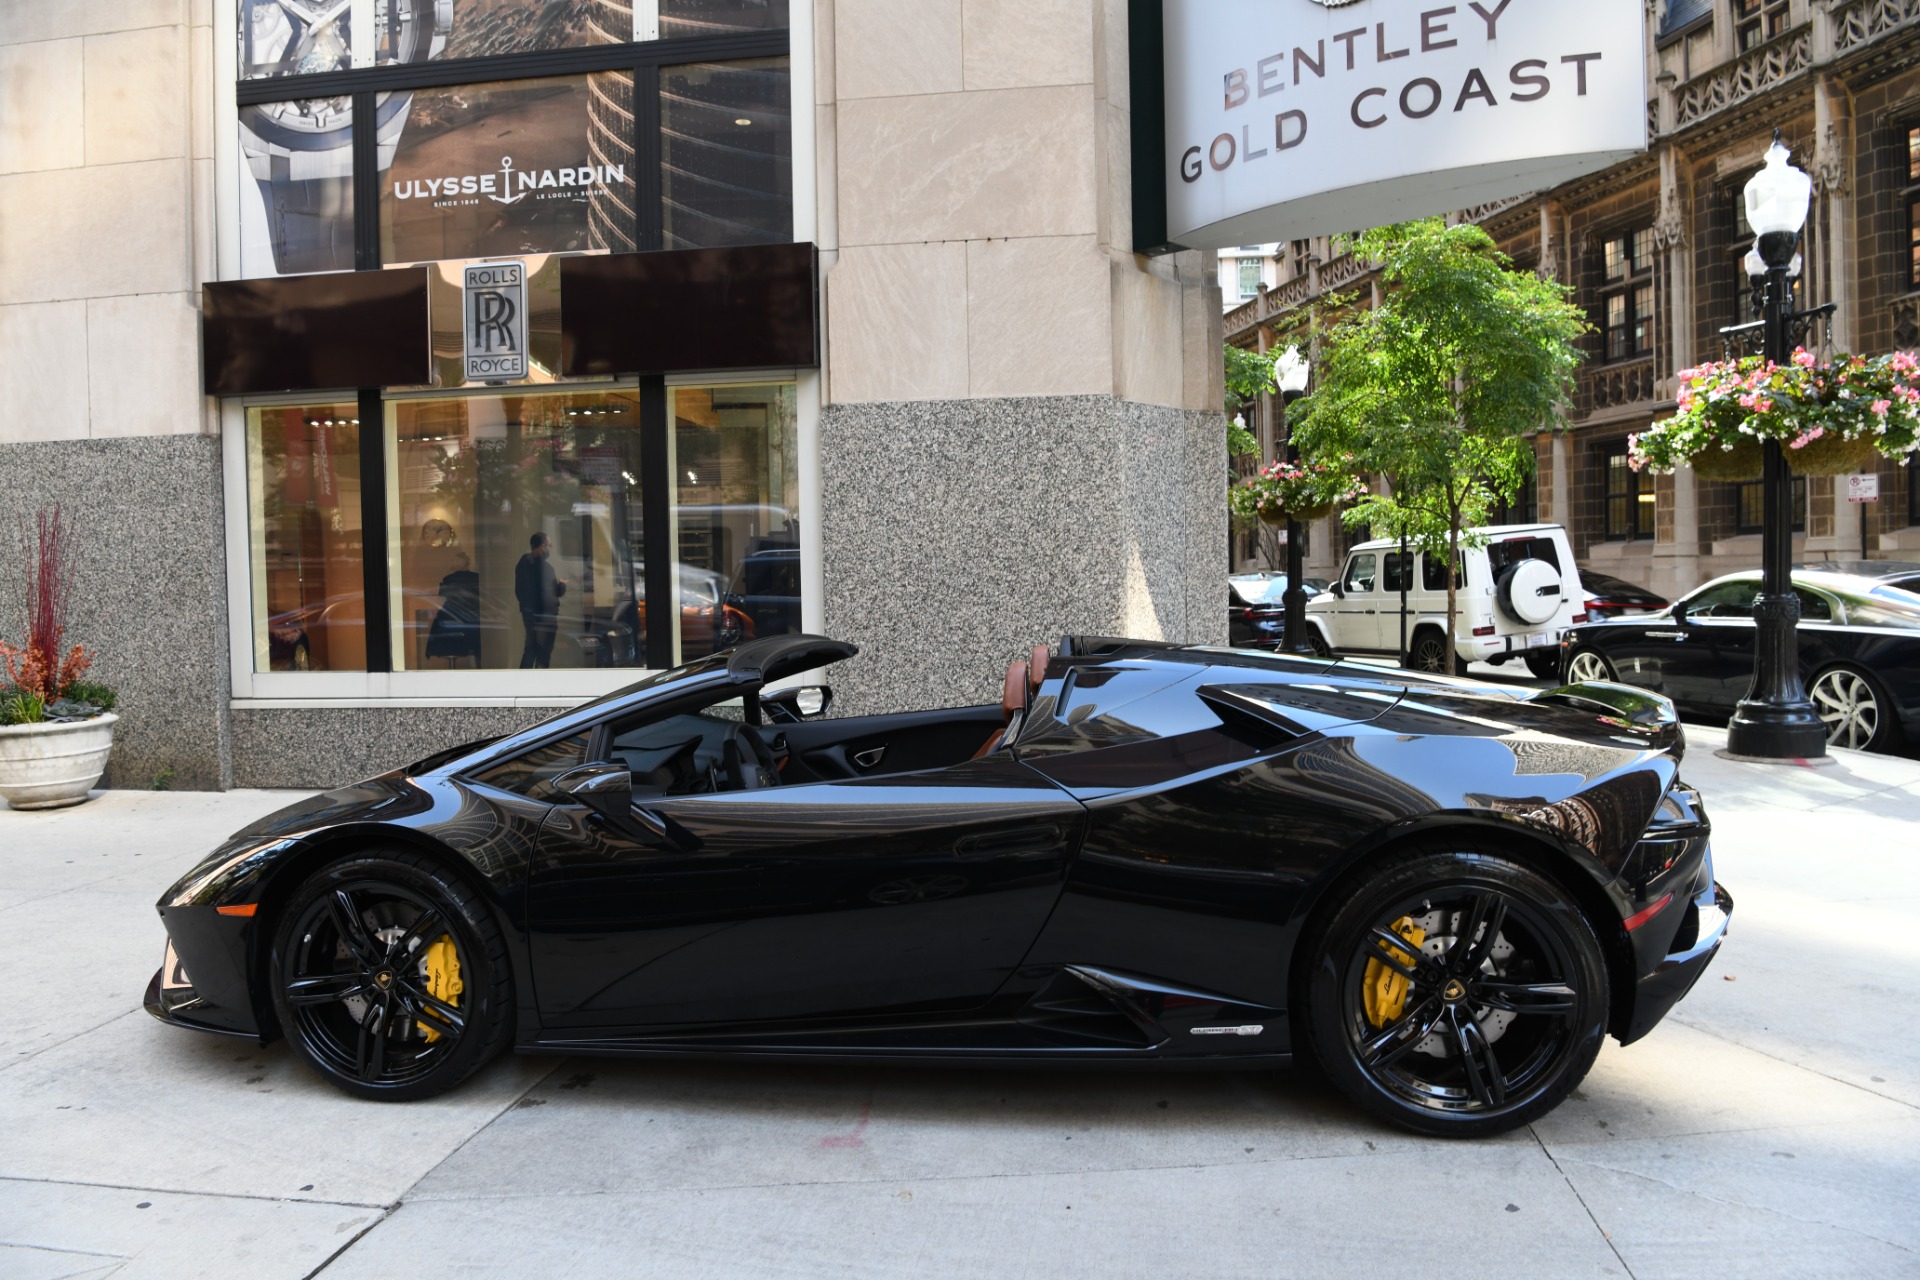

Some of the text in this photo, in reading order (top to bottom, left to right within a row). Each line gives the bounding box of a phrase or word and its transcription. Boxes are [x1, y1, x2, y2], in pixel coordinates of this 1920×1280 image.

[1223, 0, 1511, 111] BENTLEY
[1180, 52, 1602, 183] GOLD COAST
[394, 164, 624, 200] ULYSSE NARDIN
[434, 200, 458, 208] SINCE
[469, 269, 517, 285] ROLLS
[471, 358, 519, 373] ROYCE
